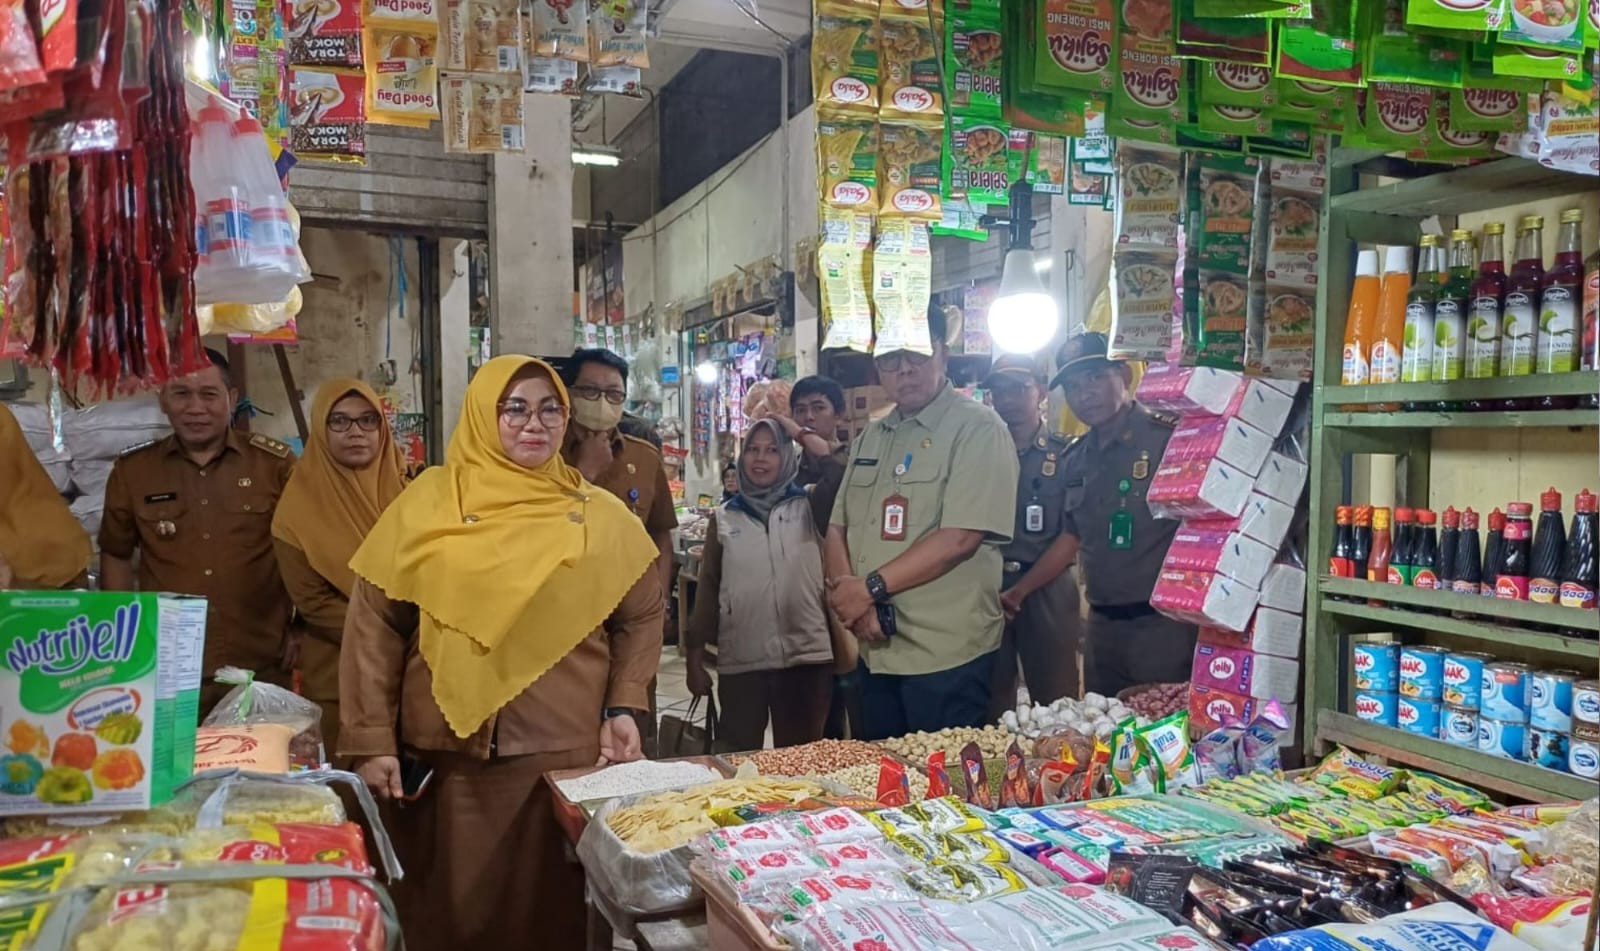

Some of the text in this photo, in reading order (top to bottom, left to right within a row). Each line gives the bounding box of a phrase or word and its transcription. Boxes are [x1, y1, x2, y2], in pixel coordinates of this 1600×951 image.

[402, 1, 432, 14] Good
[1047, 12, 1111, 31] NASI GORENG
[304, 39, 345, 48] MOKA
[1048, 29, 1112, 67] Sajiku
[310, 48, 346, 58] TORA
[1122, 49, 1159, 64] GORENG
[837, 82, 866, 97] Sasa
[971, 72, 1000, 99] eléra
[1123, 67, 1181, 102] Sajiku
[376, 90, 434, 107] Good Day
[899, 92, 930, 108] Sasa
[1378, 96, 1430, 127] Sajiku
[306, 126, 348, 136] MOKA
[312, 136, 348, 146] TORA
[838, 186, 865, 200] Sasa
[899, 193, 929, 207] Sasa
[7, 603, 141, 674] Nutrijell
[1212, 658, 1233, 675] jolly
